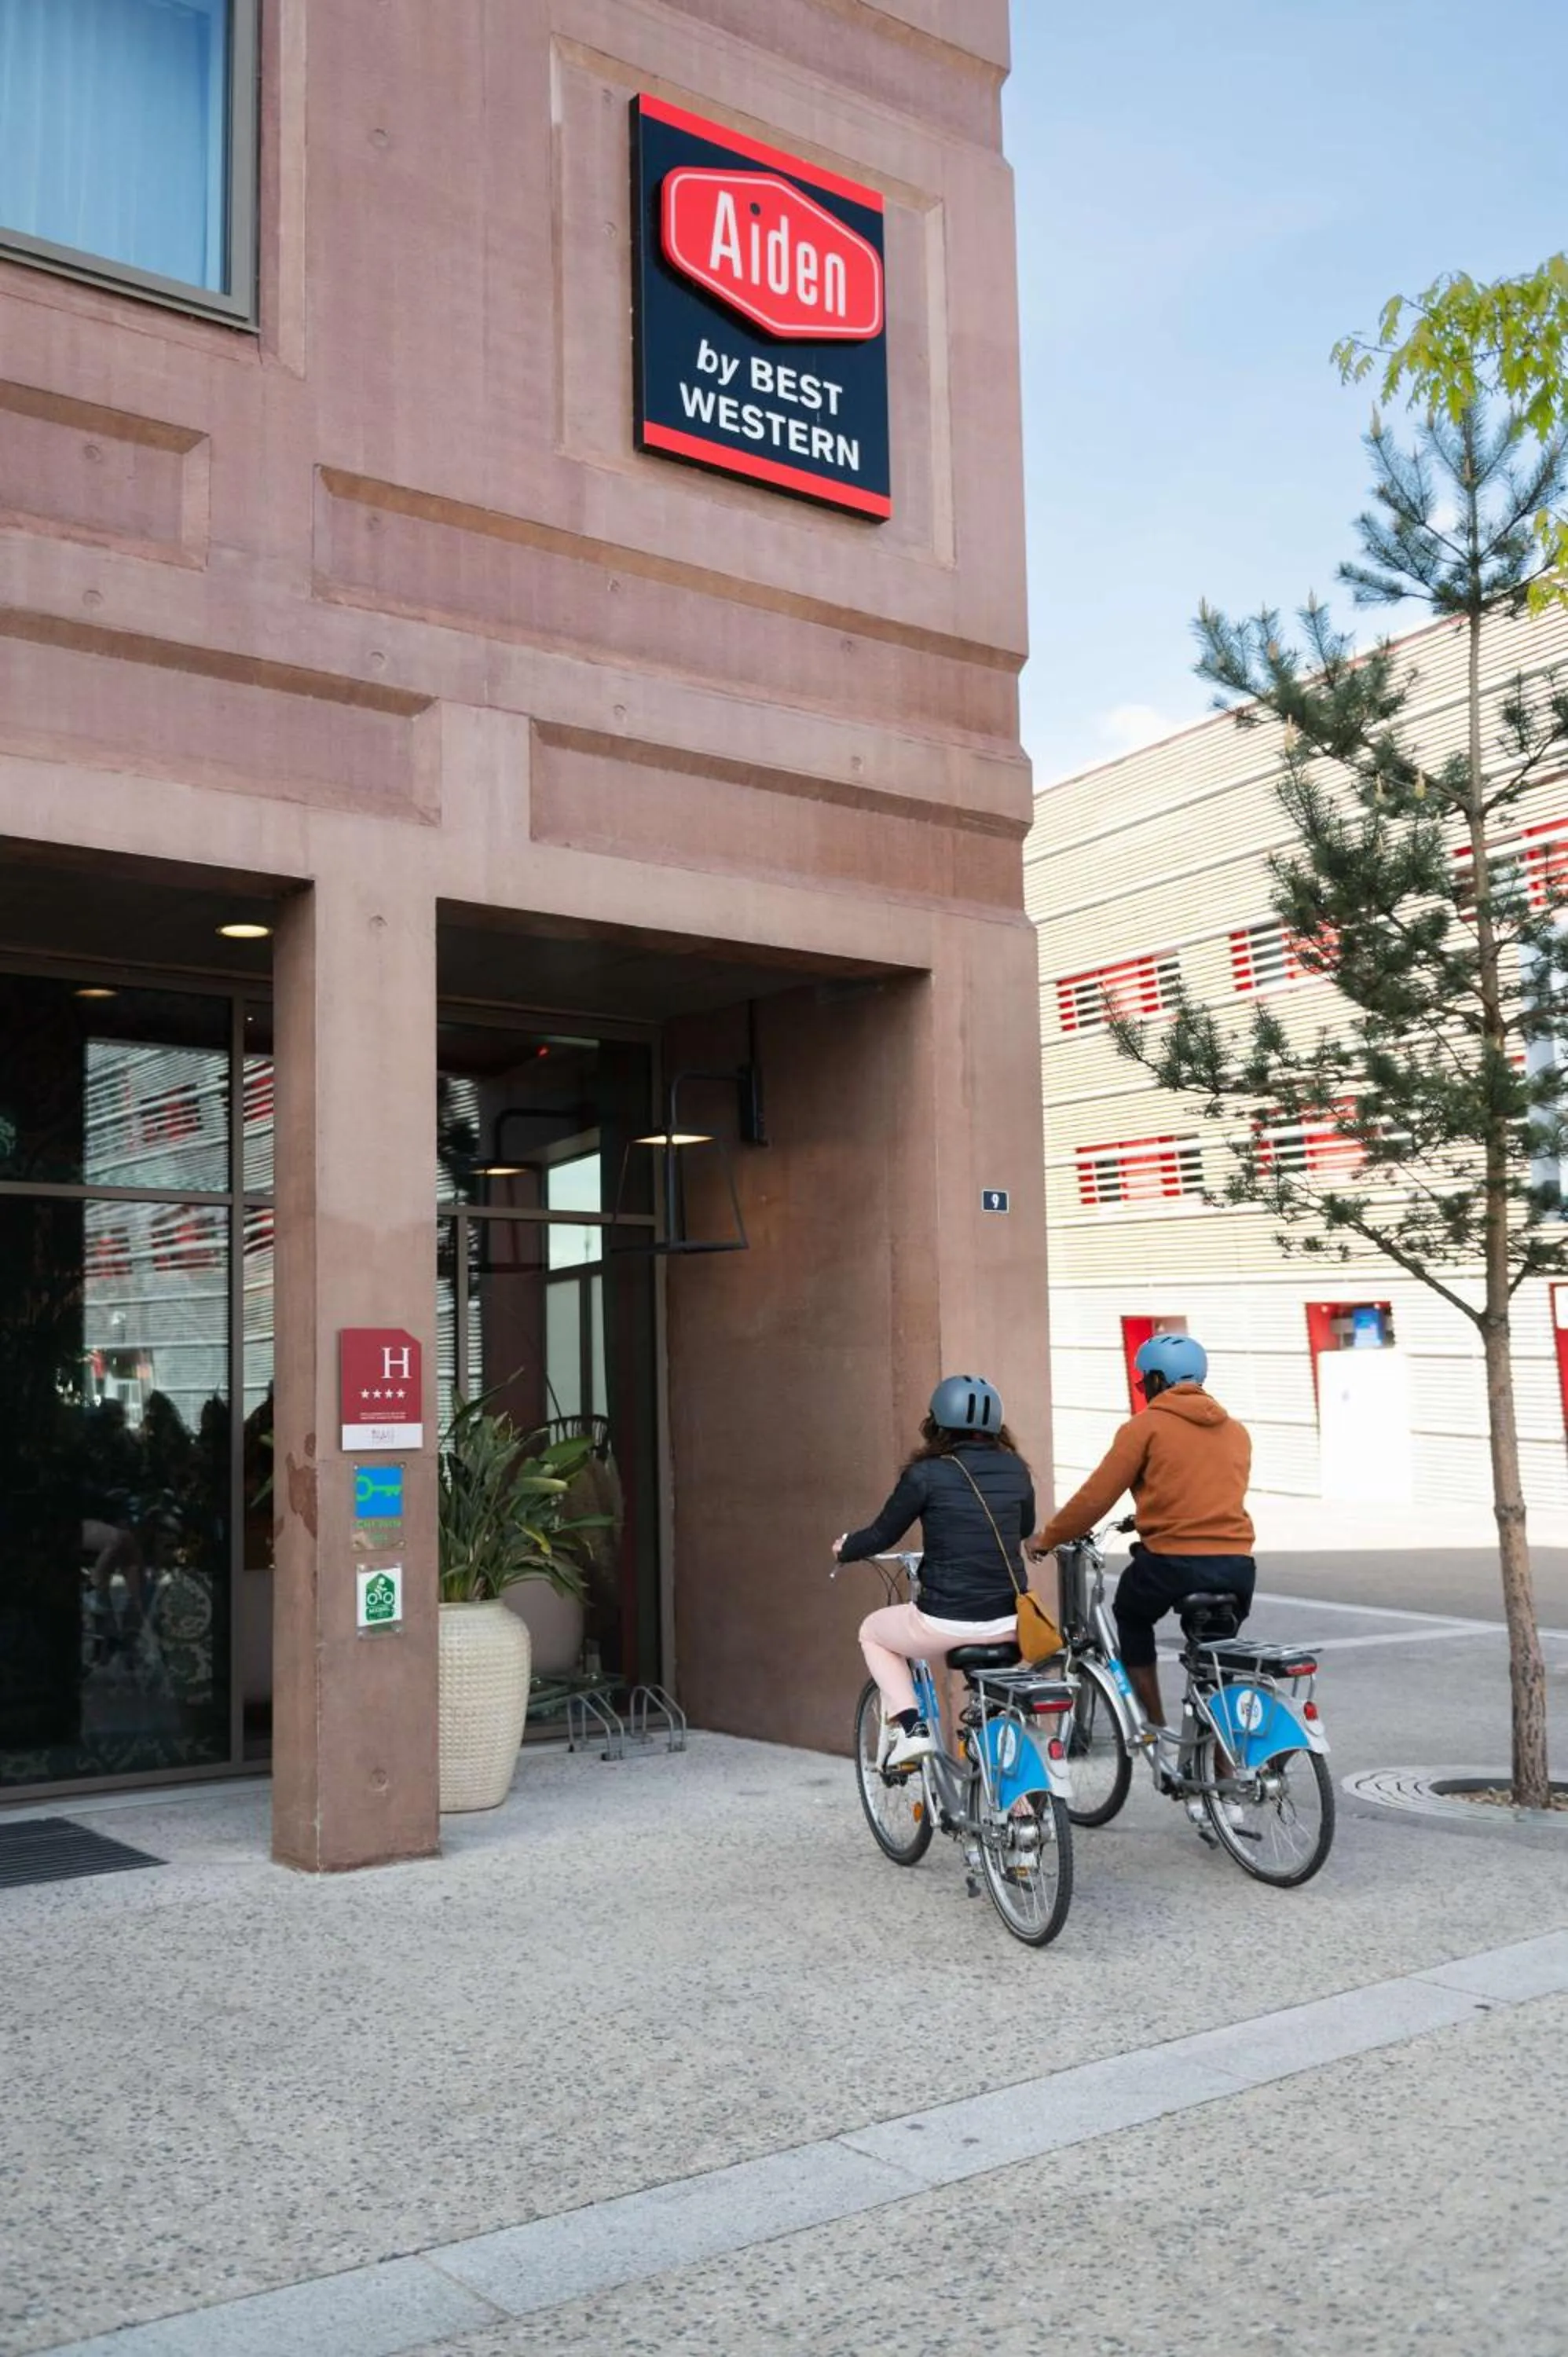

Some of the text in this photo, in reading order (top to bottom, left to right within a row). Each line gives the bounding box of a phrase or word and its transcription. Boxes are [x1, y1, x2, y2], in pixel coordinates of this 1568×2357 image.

[709, 190, 846, 318] Aiden
[696, 339, 843, 416] by BEST
[680, 381, 859, 471] WESTERN
[991, 1193, 1000, 1209] 9
[381, 1347, 412, 1379] H
